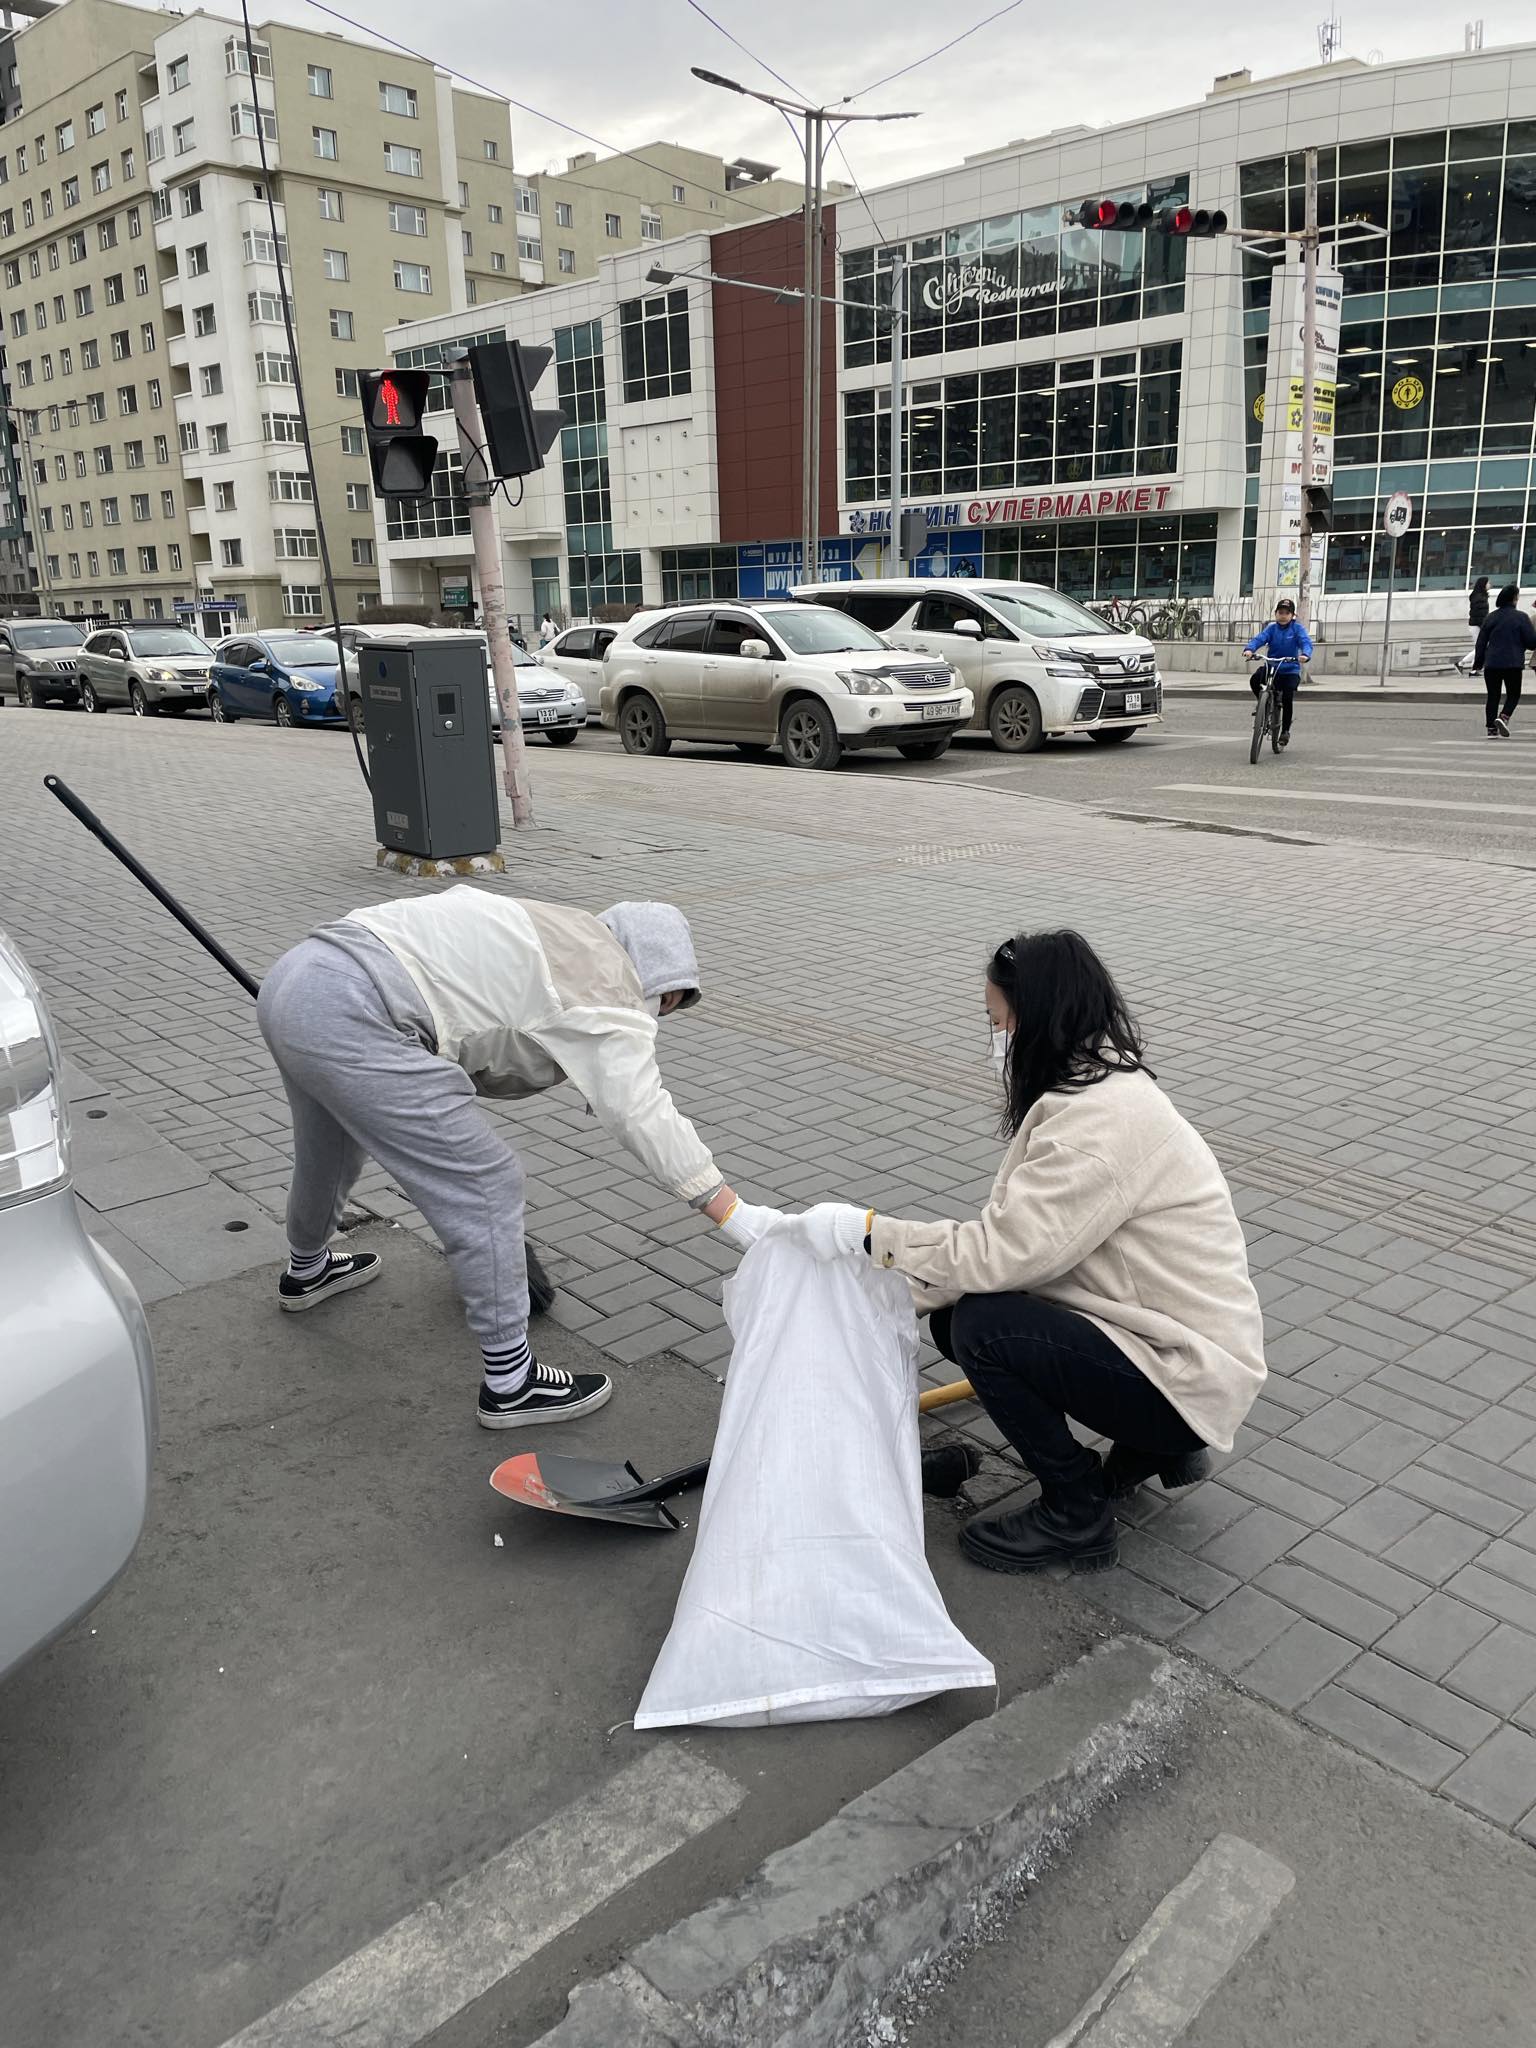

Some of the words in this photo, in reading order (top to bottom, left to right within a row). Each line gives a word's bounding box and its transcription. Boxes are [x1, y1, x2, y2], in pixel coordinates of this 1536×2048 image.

[923, 265, 1007, 314] California
[975, 277, 1066, 305] Restaurant
[869, 503, 960, 532] НИН
[967, 486, 1172, 525] СУПЕРМАРКЕТ
